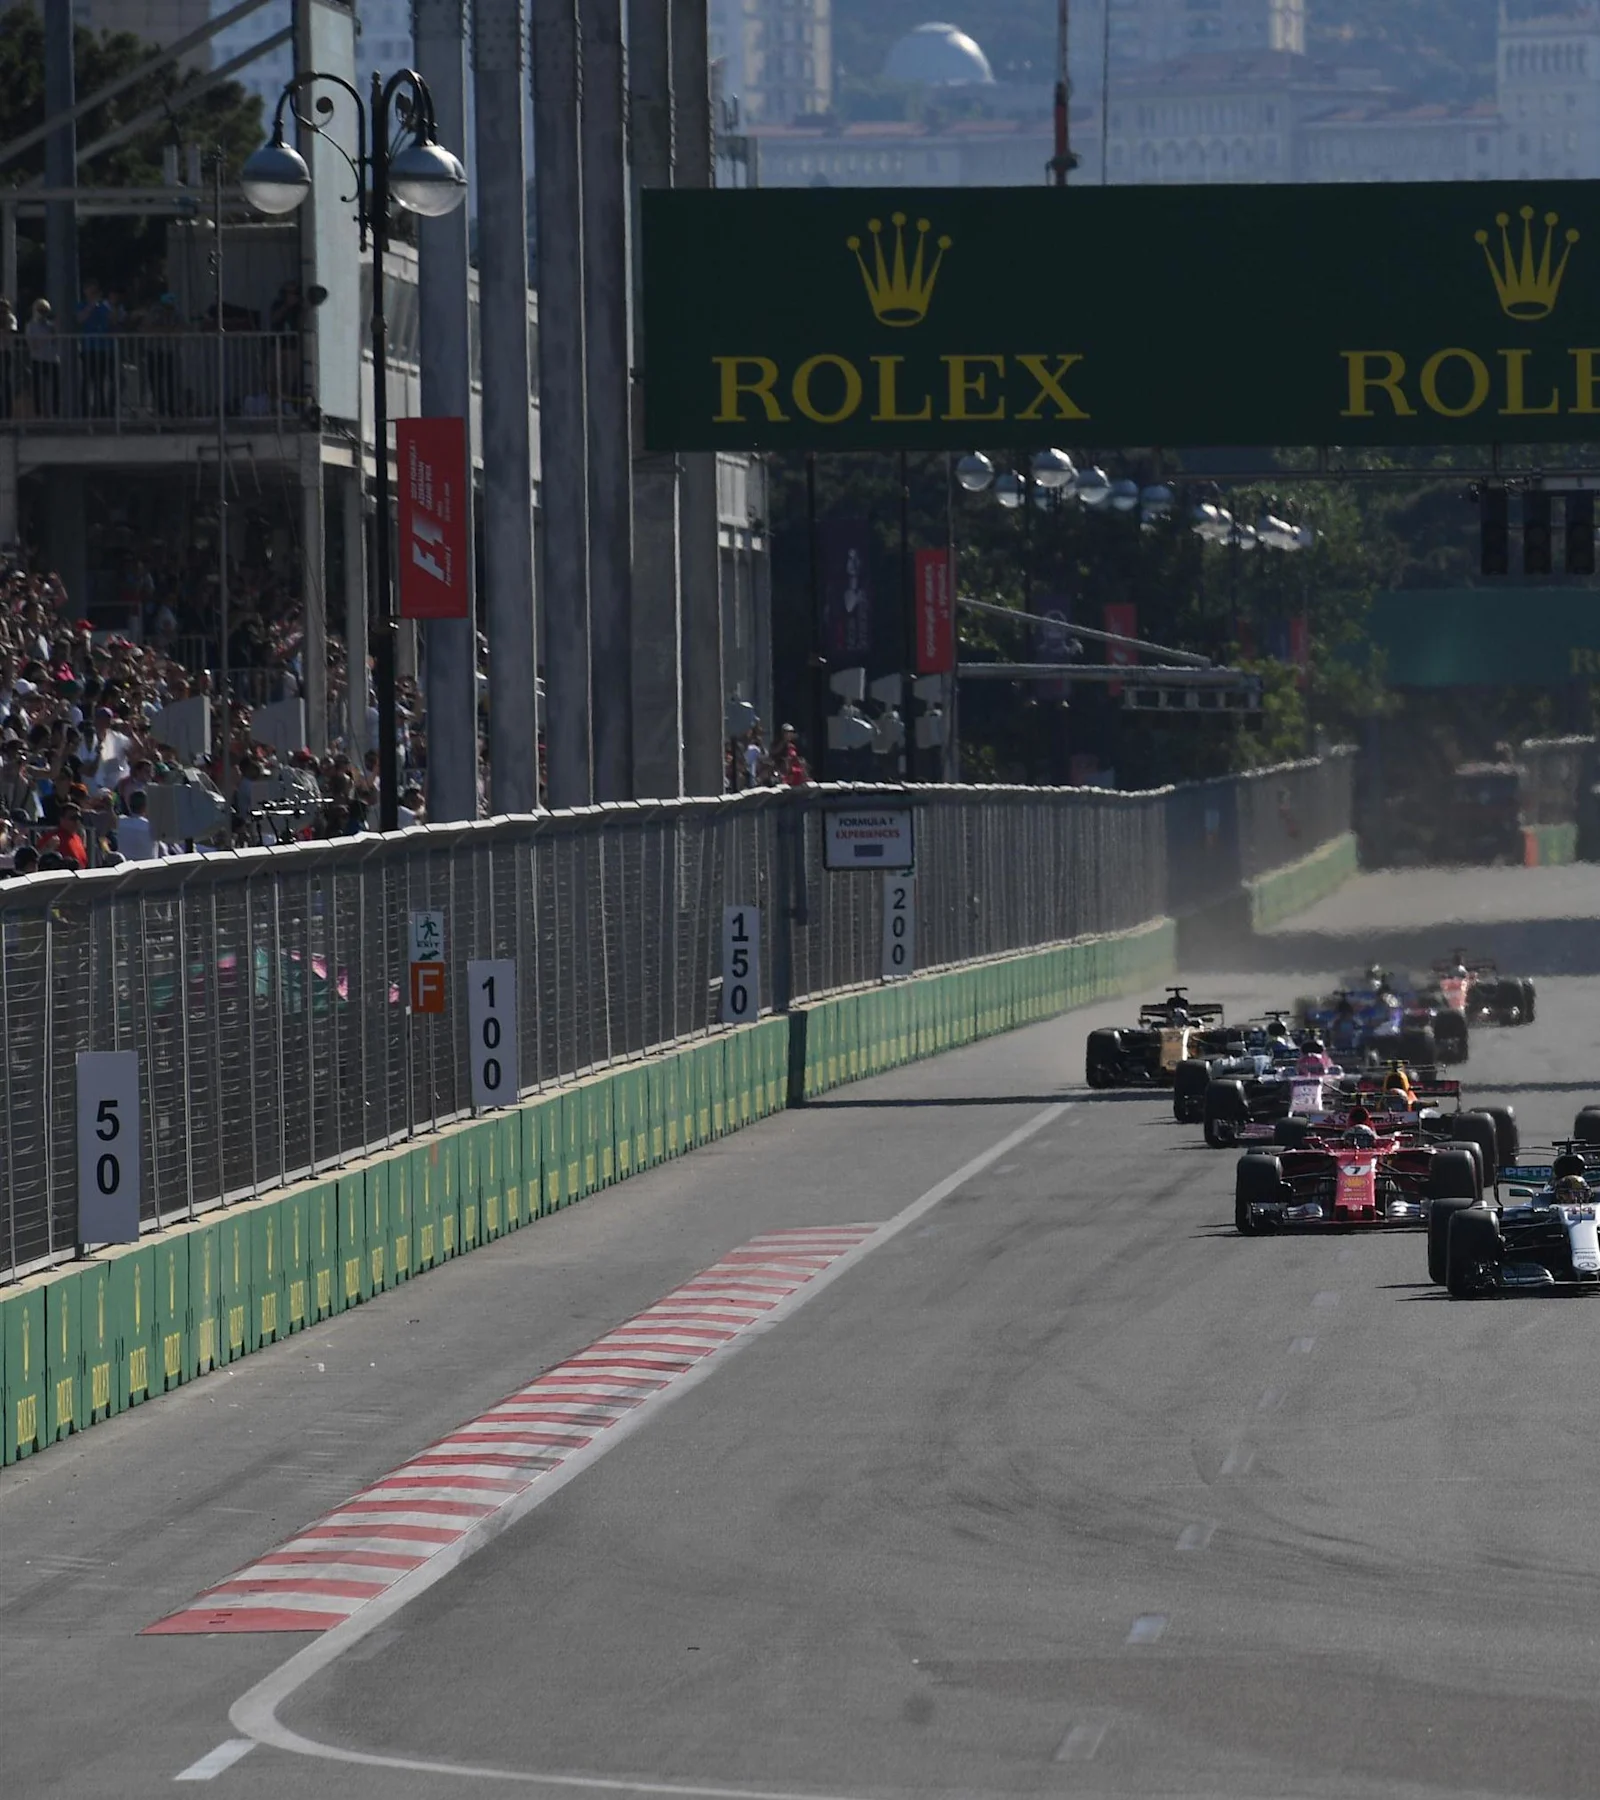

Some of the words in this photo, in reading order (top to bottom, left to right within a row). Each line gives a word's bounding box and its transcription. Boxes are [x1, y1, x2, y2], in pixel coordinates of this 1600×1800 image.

[711, 353, 1091, 423] ROLEX
[835, 828, 900, 839] EXPERIENCES
[838, 817, 887, 827] FORMULA
[891, 888, 906, 965] 200
[418, 969, 440, 1007] F
[731, 915, 749, 1015] 150
[482, 976, 501, 1090] 100
[94, 1098, 120, 1196] 50
[1350, 1166, 1361, 1175] 7
